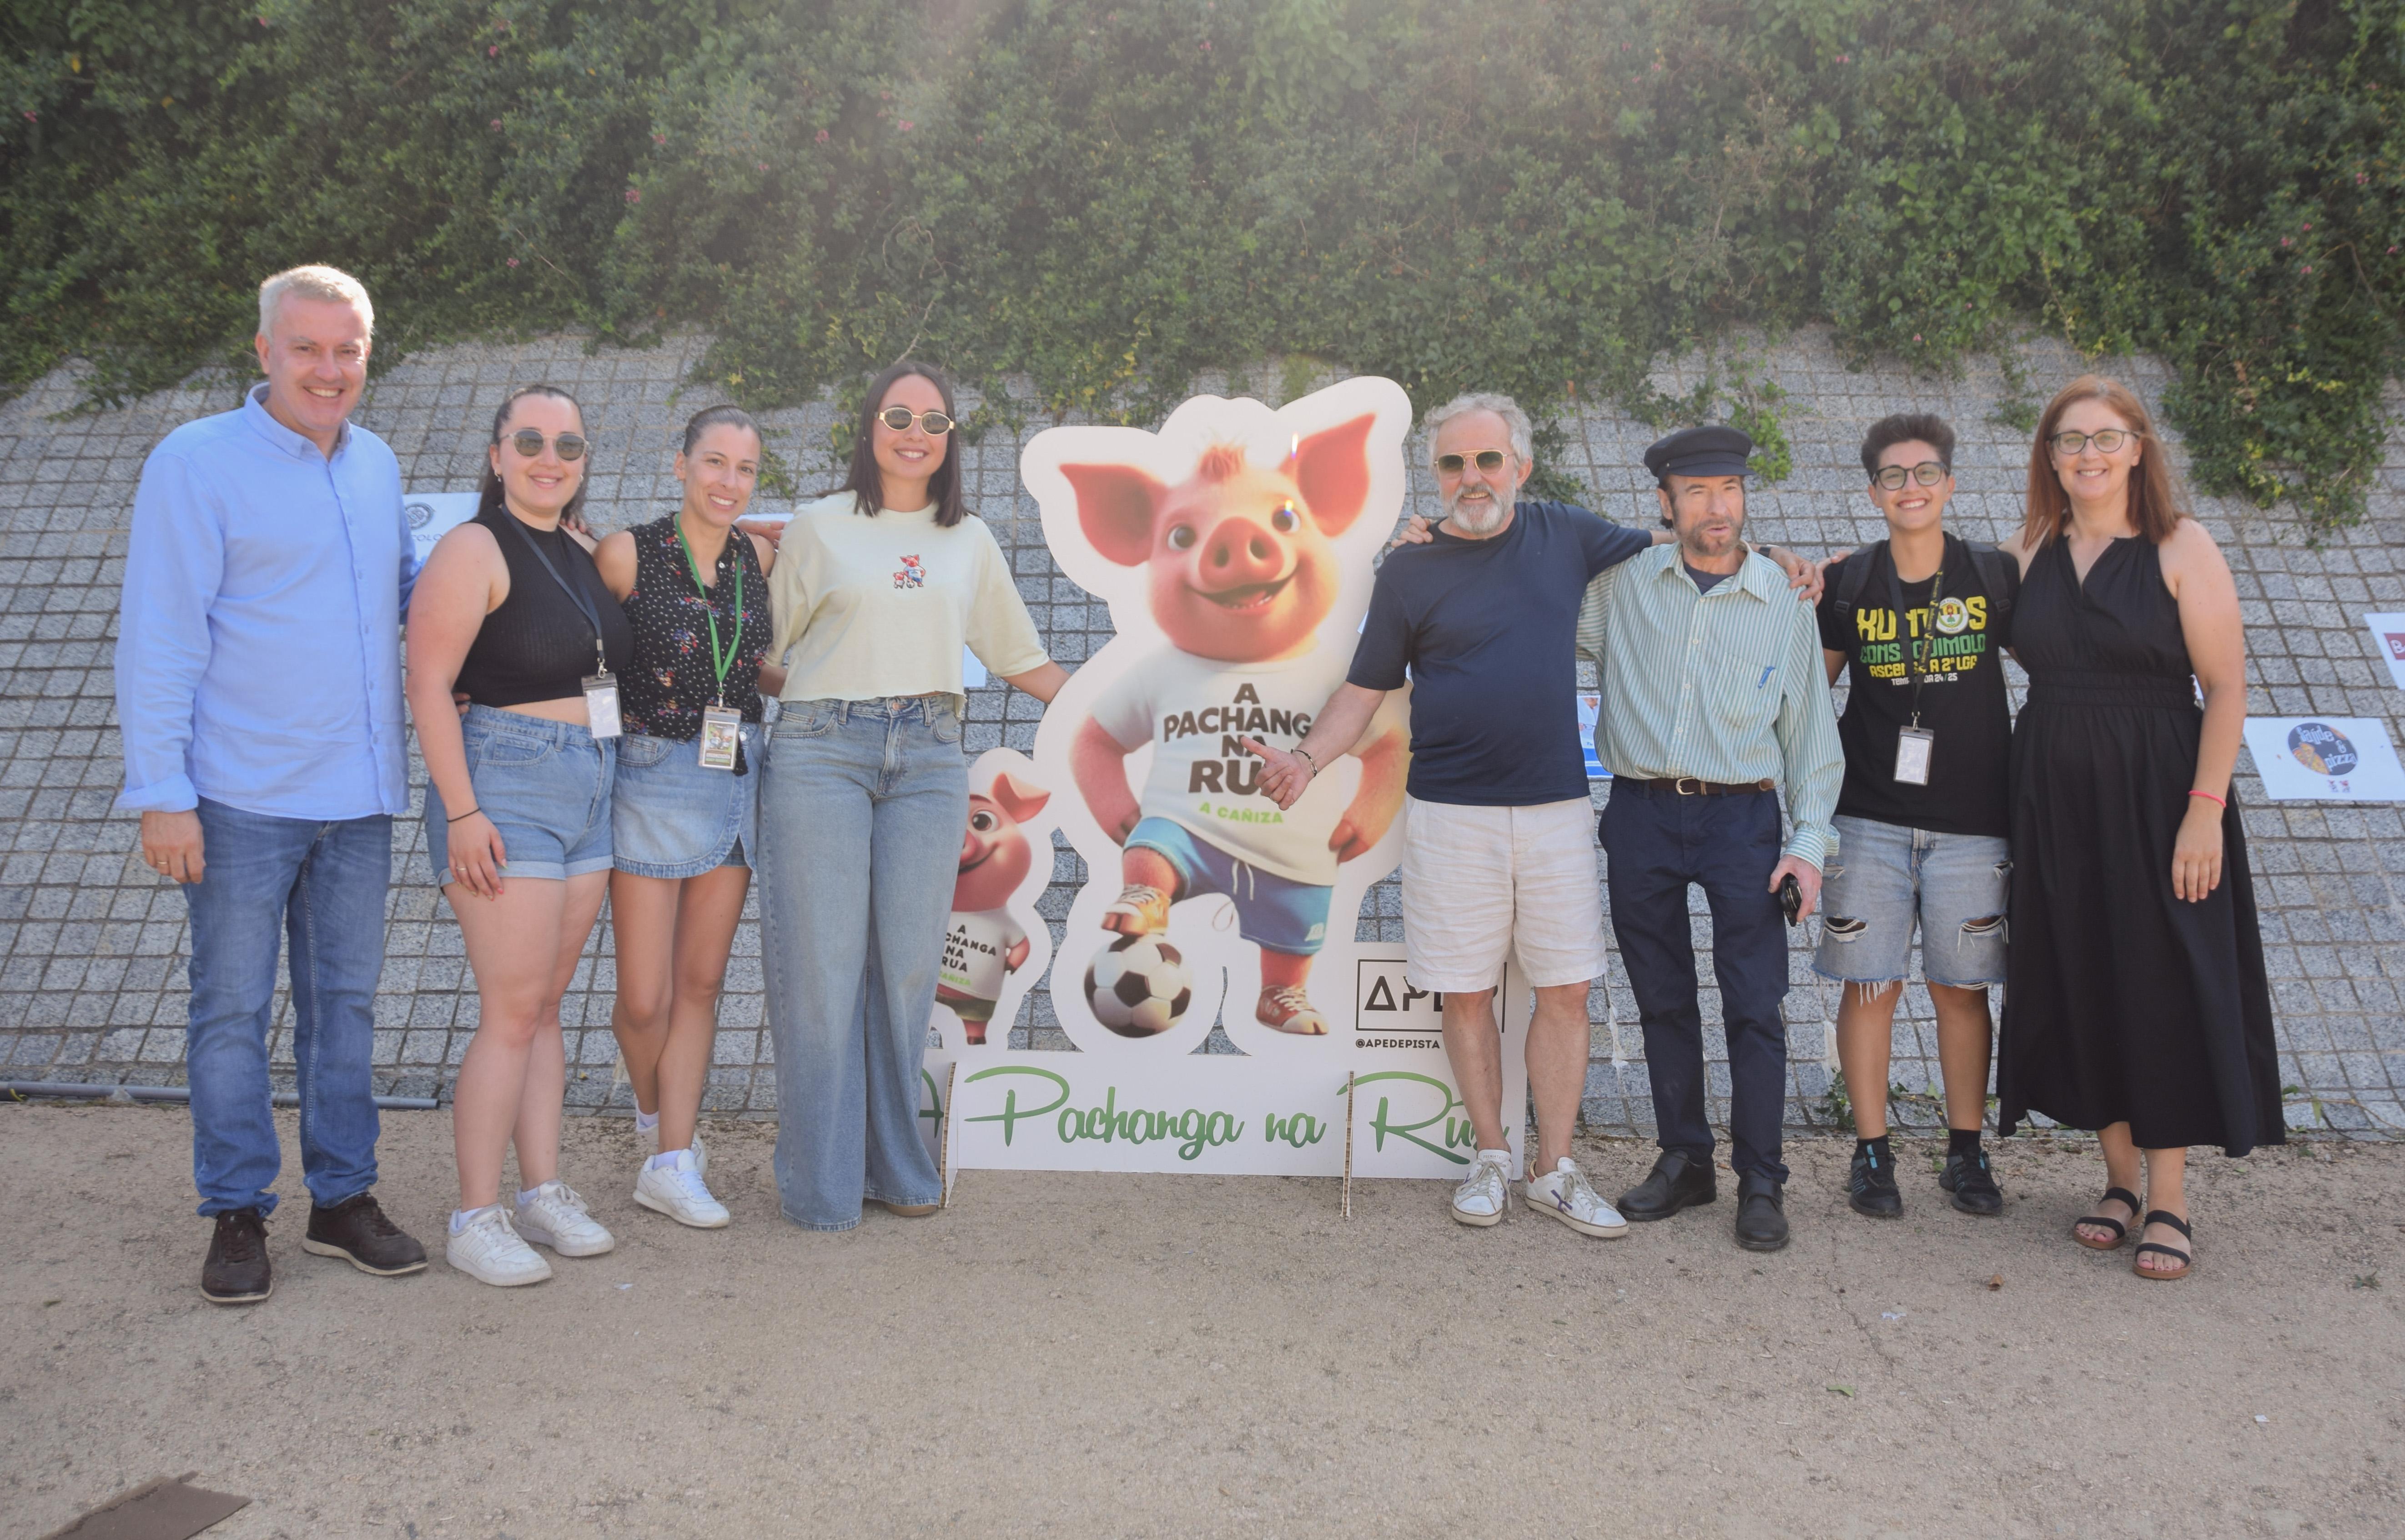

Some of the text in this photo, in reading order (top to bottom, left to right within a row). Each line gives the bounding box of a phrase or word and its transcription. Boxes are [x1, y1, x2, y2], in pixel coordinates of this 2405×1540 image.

[1929, 659, 1939, 673] A
[1956, 655, 1977, 670] LGF
[1233, 683, 1260, 705] A
[1164, 706, 1311, 743] PACHANG
[1188, 760, 1262, 795] RU
[1199, 802, 1283, 824] A CAÑIZA
[957, 924, 966, 935] A
[946, 932, 996, 956] CHANGA
[946, 945, 964, 958] NA
[941, 956, 967, 972] RUA
[1355, 1038, 1440, 1049] @APEDEPISTA
[964, 1066, 1245, 1160] Pachanga
[1265, 1112, 1327, 1148] na
[1336, 1071, 1510, 1165] Ru
